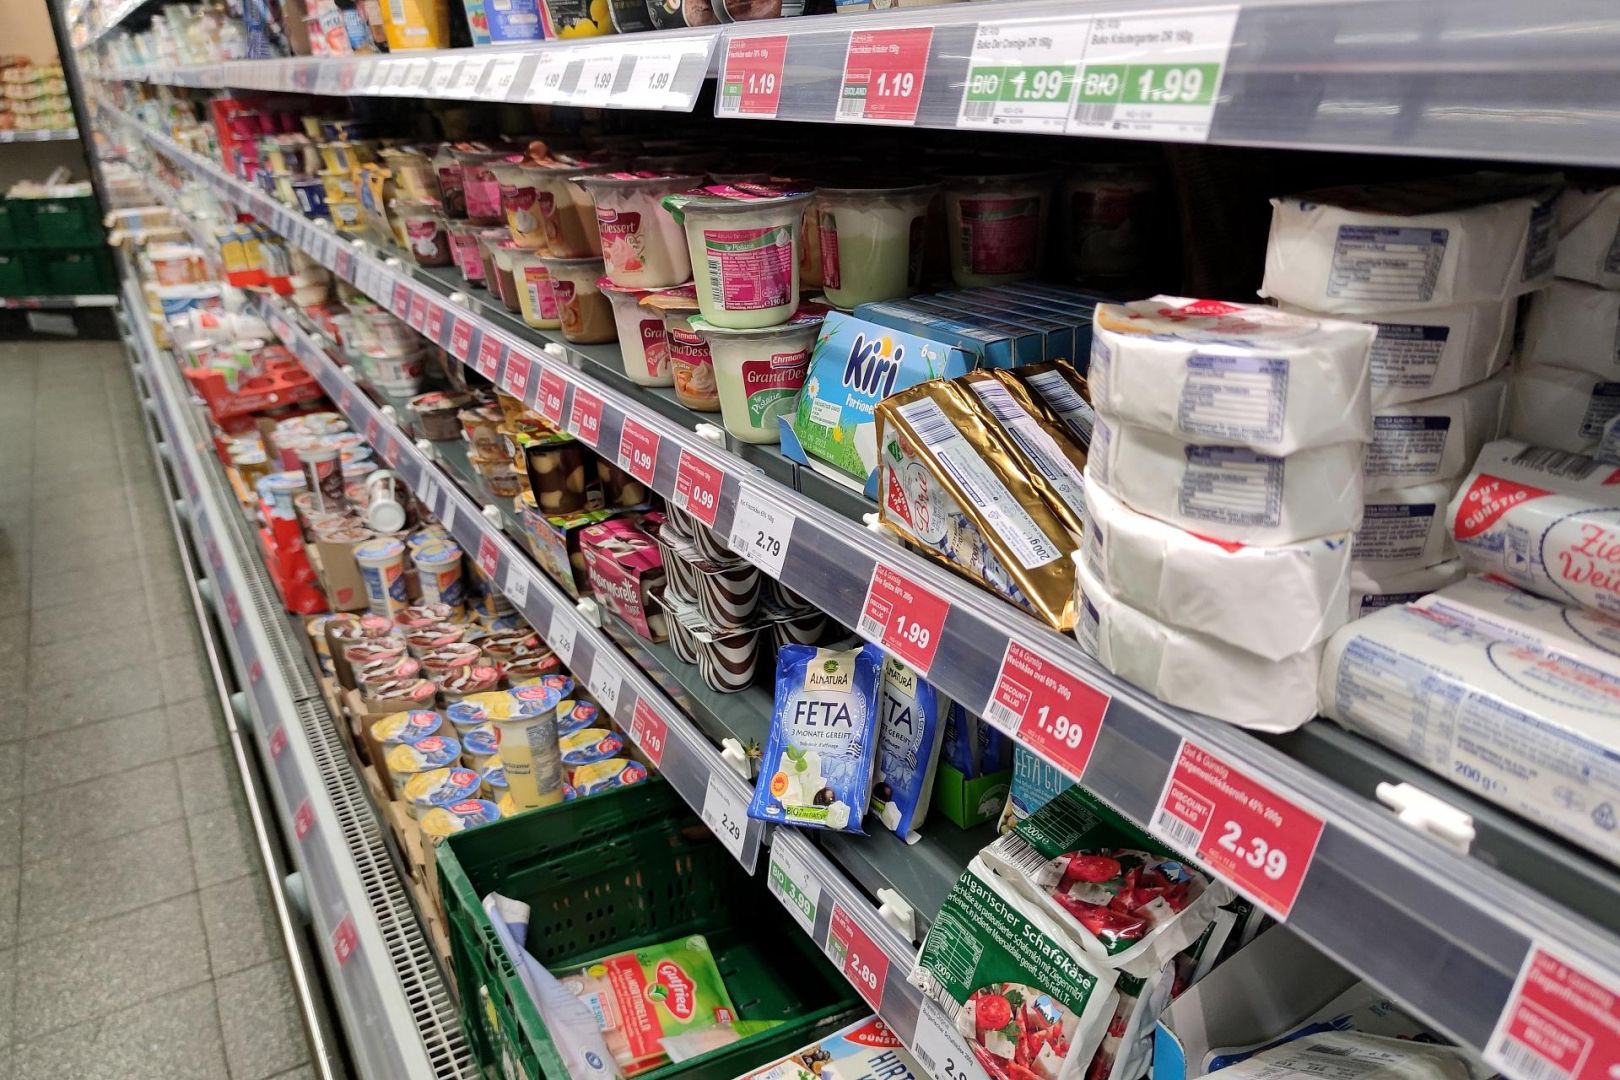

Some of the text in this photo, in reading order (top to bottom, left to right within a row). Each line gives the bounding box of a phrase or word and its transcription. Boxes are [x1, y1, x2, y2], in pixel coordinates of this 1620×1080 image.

[648, 73, 669, 89] 1.99
[747, 73, 775, 94] 1.19
[874, 73, 915, 97] 1.19
[972, 74, 998, 94] BIO
[1012, 71, 1064, 99] 1.99
[1086, 73, 1119, 97] BIO
[1139, 69, 1204, 101] 1.99
[771, 353, 805, 366] Ehrmann
[844, 334, 903, 399] Kiri
[747, 369, 785, 383] Grand
[751, 392, 781, 415] Pistazie
[846, 393, 876, 415] Portione
[582, 413, 597, 431] 0.99
[634, 448, 651, 470] 0.99
[693, 484, 714, 510] 0.99
[915, 471, 930, 533] Brie
[1468, 482, 1499, 502] GUT
[1464, 490, 1527, 529] GÜNSTIG
[755, 530, 781, 557] 2.79
[896, 615, 930, 648] 1.99
[1010, 644, 1020, 656] Gut
[1025, 651, 1043, 670] Günstig
[1007, 655, 1034, 681] Weichkäse
[1033, 670, 1045, 685] oval
[1056, 683, 1072, 701] 200g
[1000, 681, 1028, 702] DISCOUNT-
[1003, 692, 1020, 708] BILLIG
[793, 700, 853, 728] FETA
[884, 692, 913, 736] TA
[1037, 705, 1083, 749] 1.99
[645, 730, 661, 752] 1.19
[791, 728, 852, 740] 3 MONATE GEREIFT
[1015, 748, 1040, 786] FETA
[1184, 743, 1196, 756] Gut
[1202, 753, 1229, 778] Günstig
[1454, 760, 1480, 784] 200
[1175, 803, 1198, 822] BILLIG
[1263, 805, 1283, 828] 200g
[721, 813, 740, 840] 2.29
[1217, 820, 1288, 880] 2.39
[772, 866, 784, 884] BIO
[789, 883, 811, 916] 3.99
[1022, 924, 1092, 991] Schafskäse
[850, 952, 877, 990] 2.89
[659, 964, 691, 1016] Gutfried
[1048, 967, 1084, 1003] Ziegenmilch
